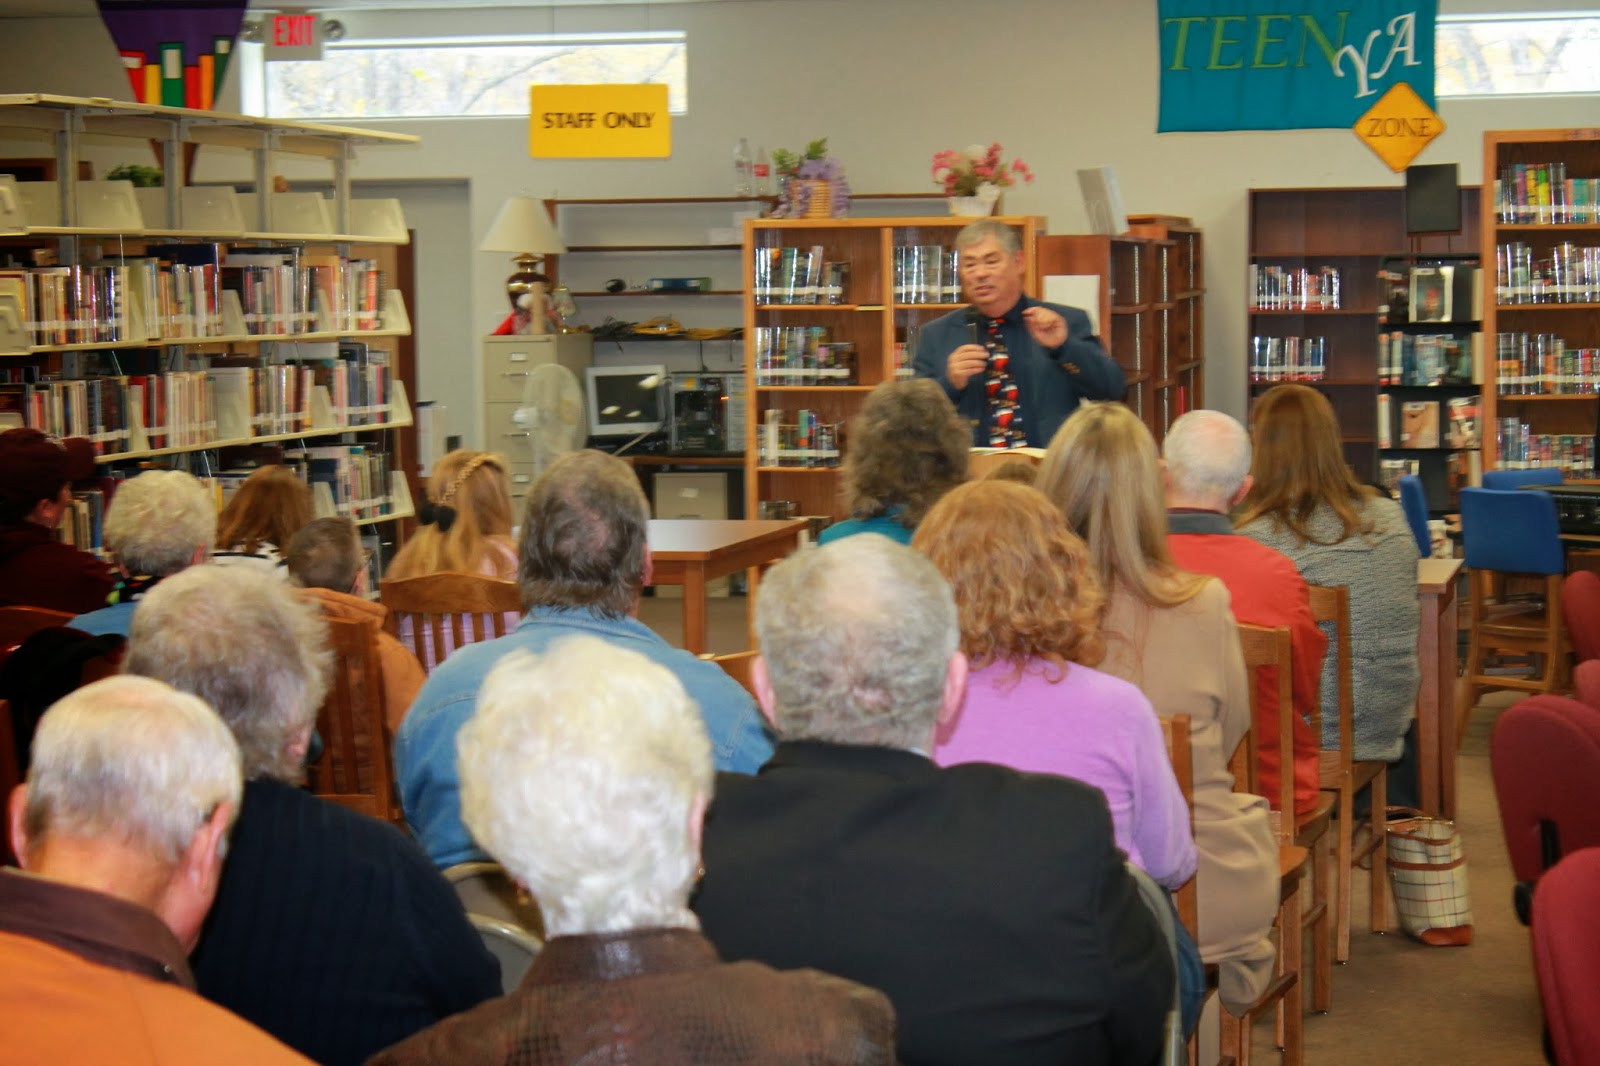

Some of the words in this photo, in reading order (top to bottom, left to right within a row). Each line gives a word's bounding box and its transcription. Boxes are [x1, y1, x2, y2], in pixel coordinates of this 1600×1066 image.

[275, 15, 315, 46] EXIT
[1164, 12, 1351, 71] TEEN
[1333, 12, 1421, 98] YA
[543, 112, 596, 129] STAFF
[604, 112, 655, 129] ONLY
[1368, 118, 1432, 138] ZONE
